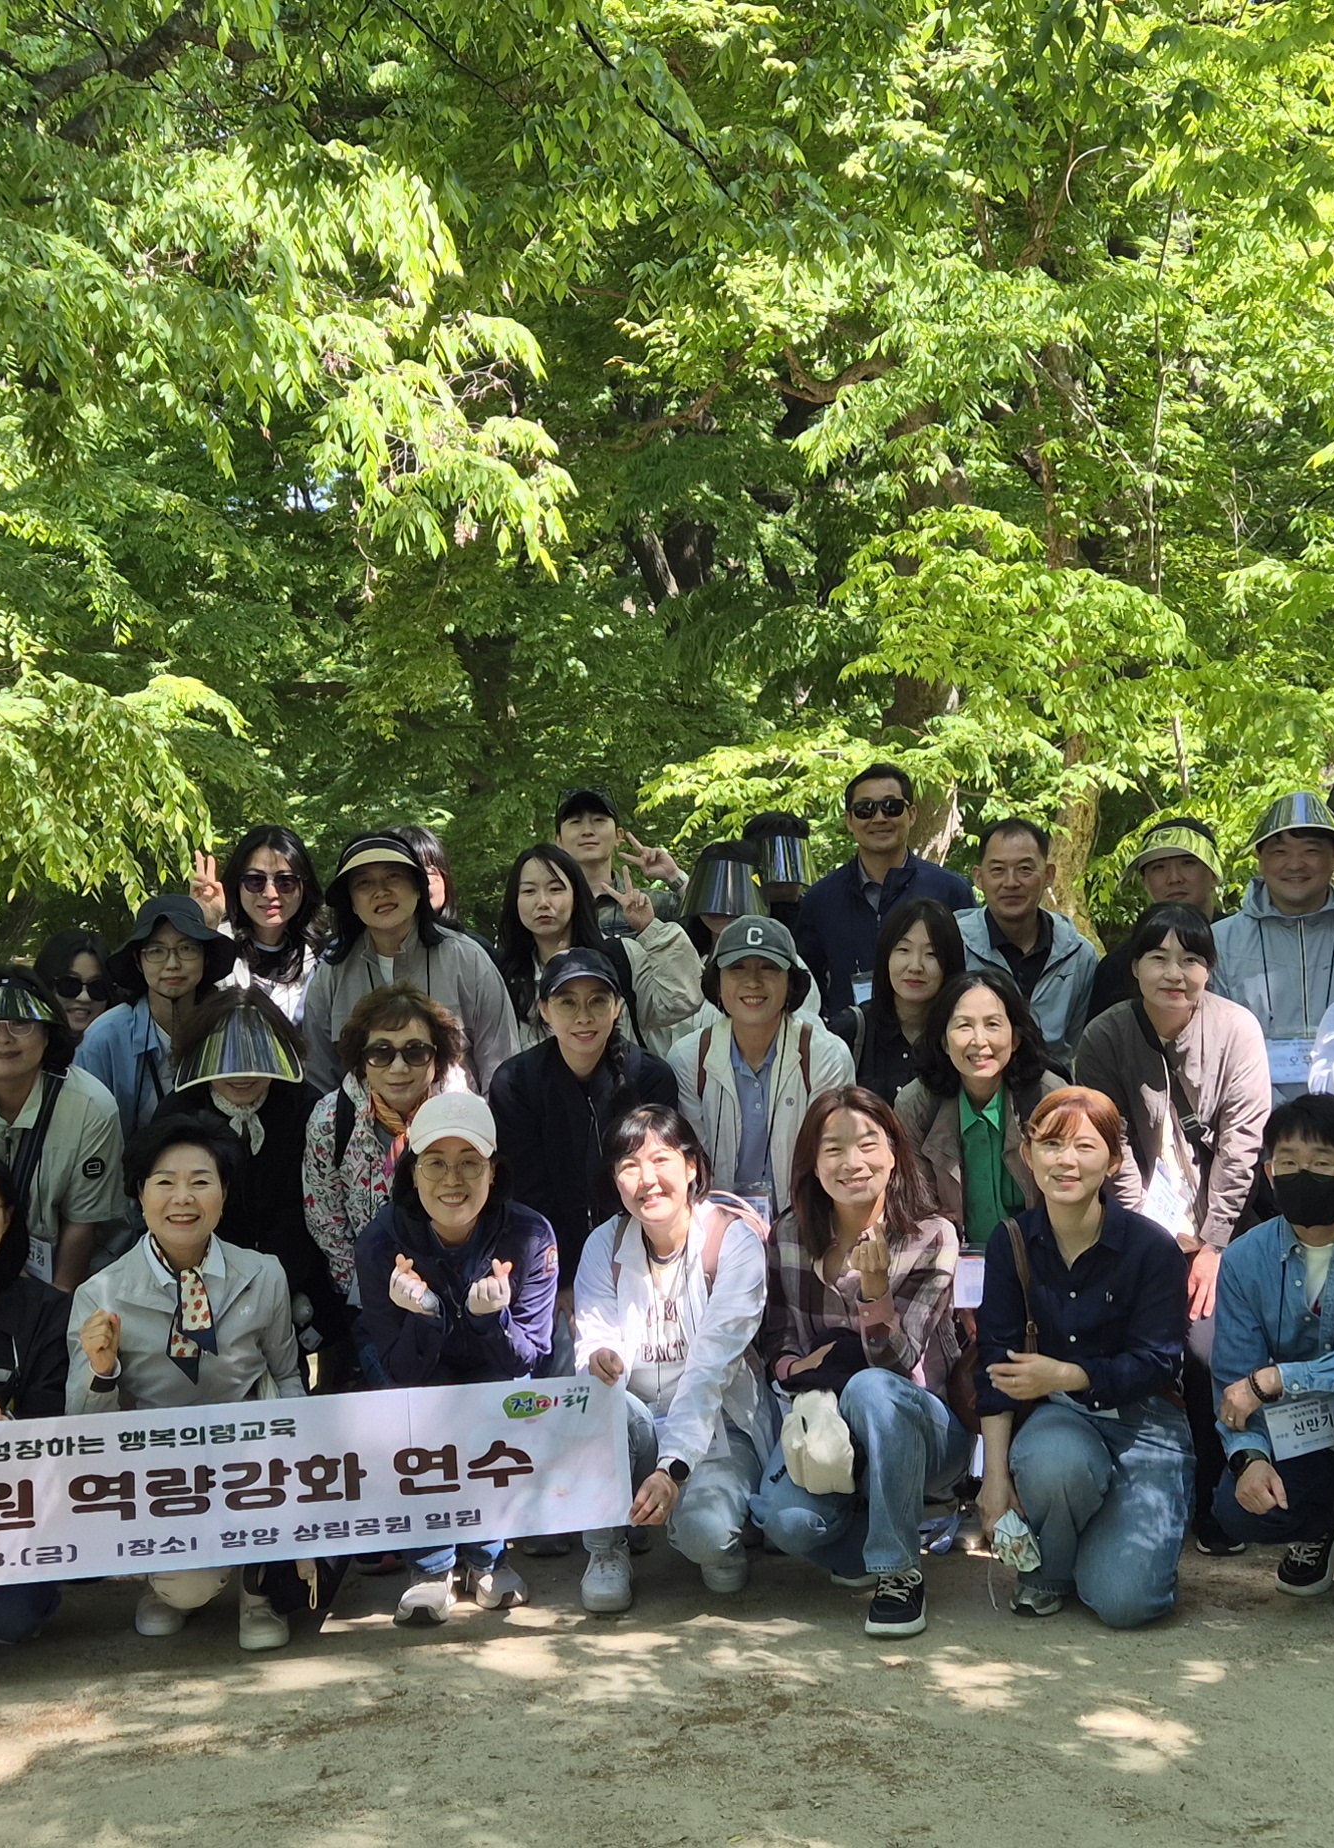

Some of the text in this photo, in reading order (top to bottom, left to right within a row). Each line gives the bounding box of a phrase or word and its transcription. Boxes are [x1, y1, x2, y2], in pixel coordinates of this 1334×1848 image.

[747, 926, 763, 946] C
[117, 1418, 296, 1452] 행복의령교육
[1293, 1412, 1334, 1437] 신만기
[68, 1452, 368, 1520] 역량강화
[393, 1440, 535, 1496] 연수
[219, 1526, 280, 1549] 함양
[292, 1515, 411, 1542] 상림공원
[424, 1508, 482, 1530] 일원
